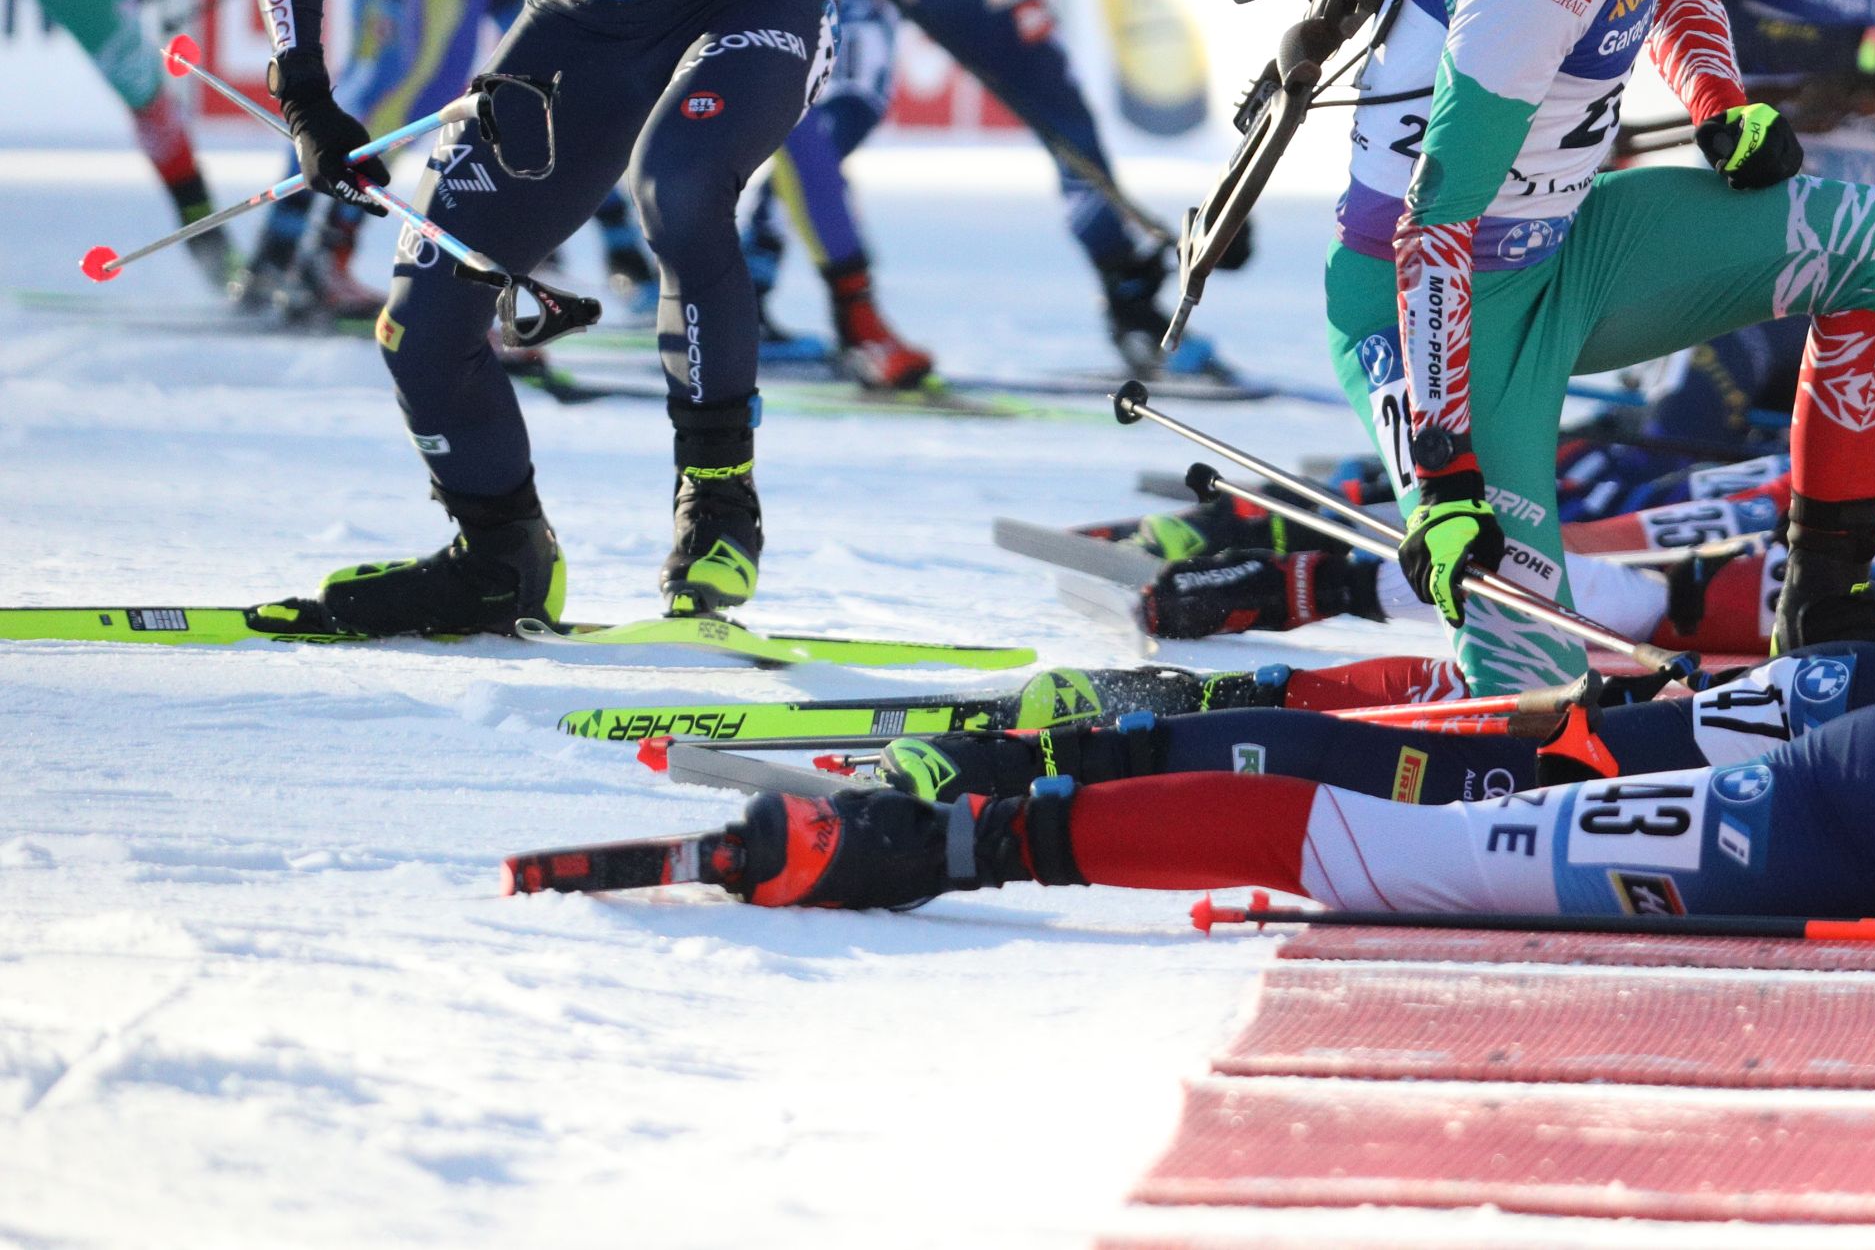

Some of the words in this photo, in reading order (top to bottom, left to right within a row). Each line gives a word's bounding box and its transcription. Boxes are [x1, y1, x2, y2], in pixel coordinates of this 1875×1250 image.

[686, 303, 703, 403] UADRO
[1428, 274, 1444, 401] MOTO-PFOHE
[1503, 546, 1555, 581] FOHE
[607, 712, 747, 741] FISCHER
[1699, 684, 1791, 742] 47
[1578, 782, 1696, 837] 43
